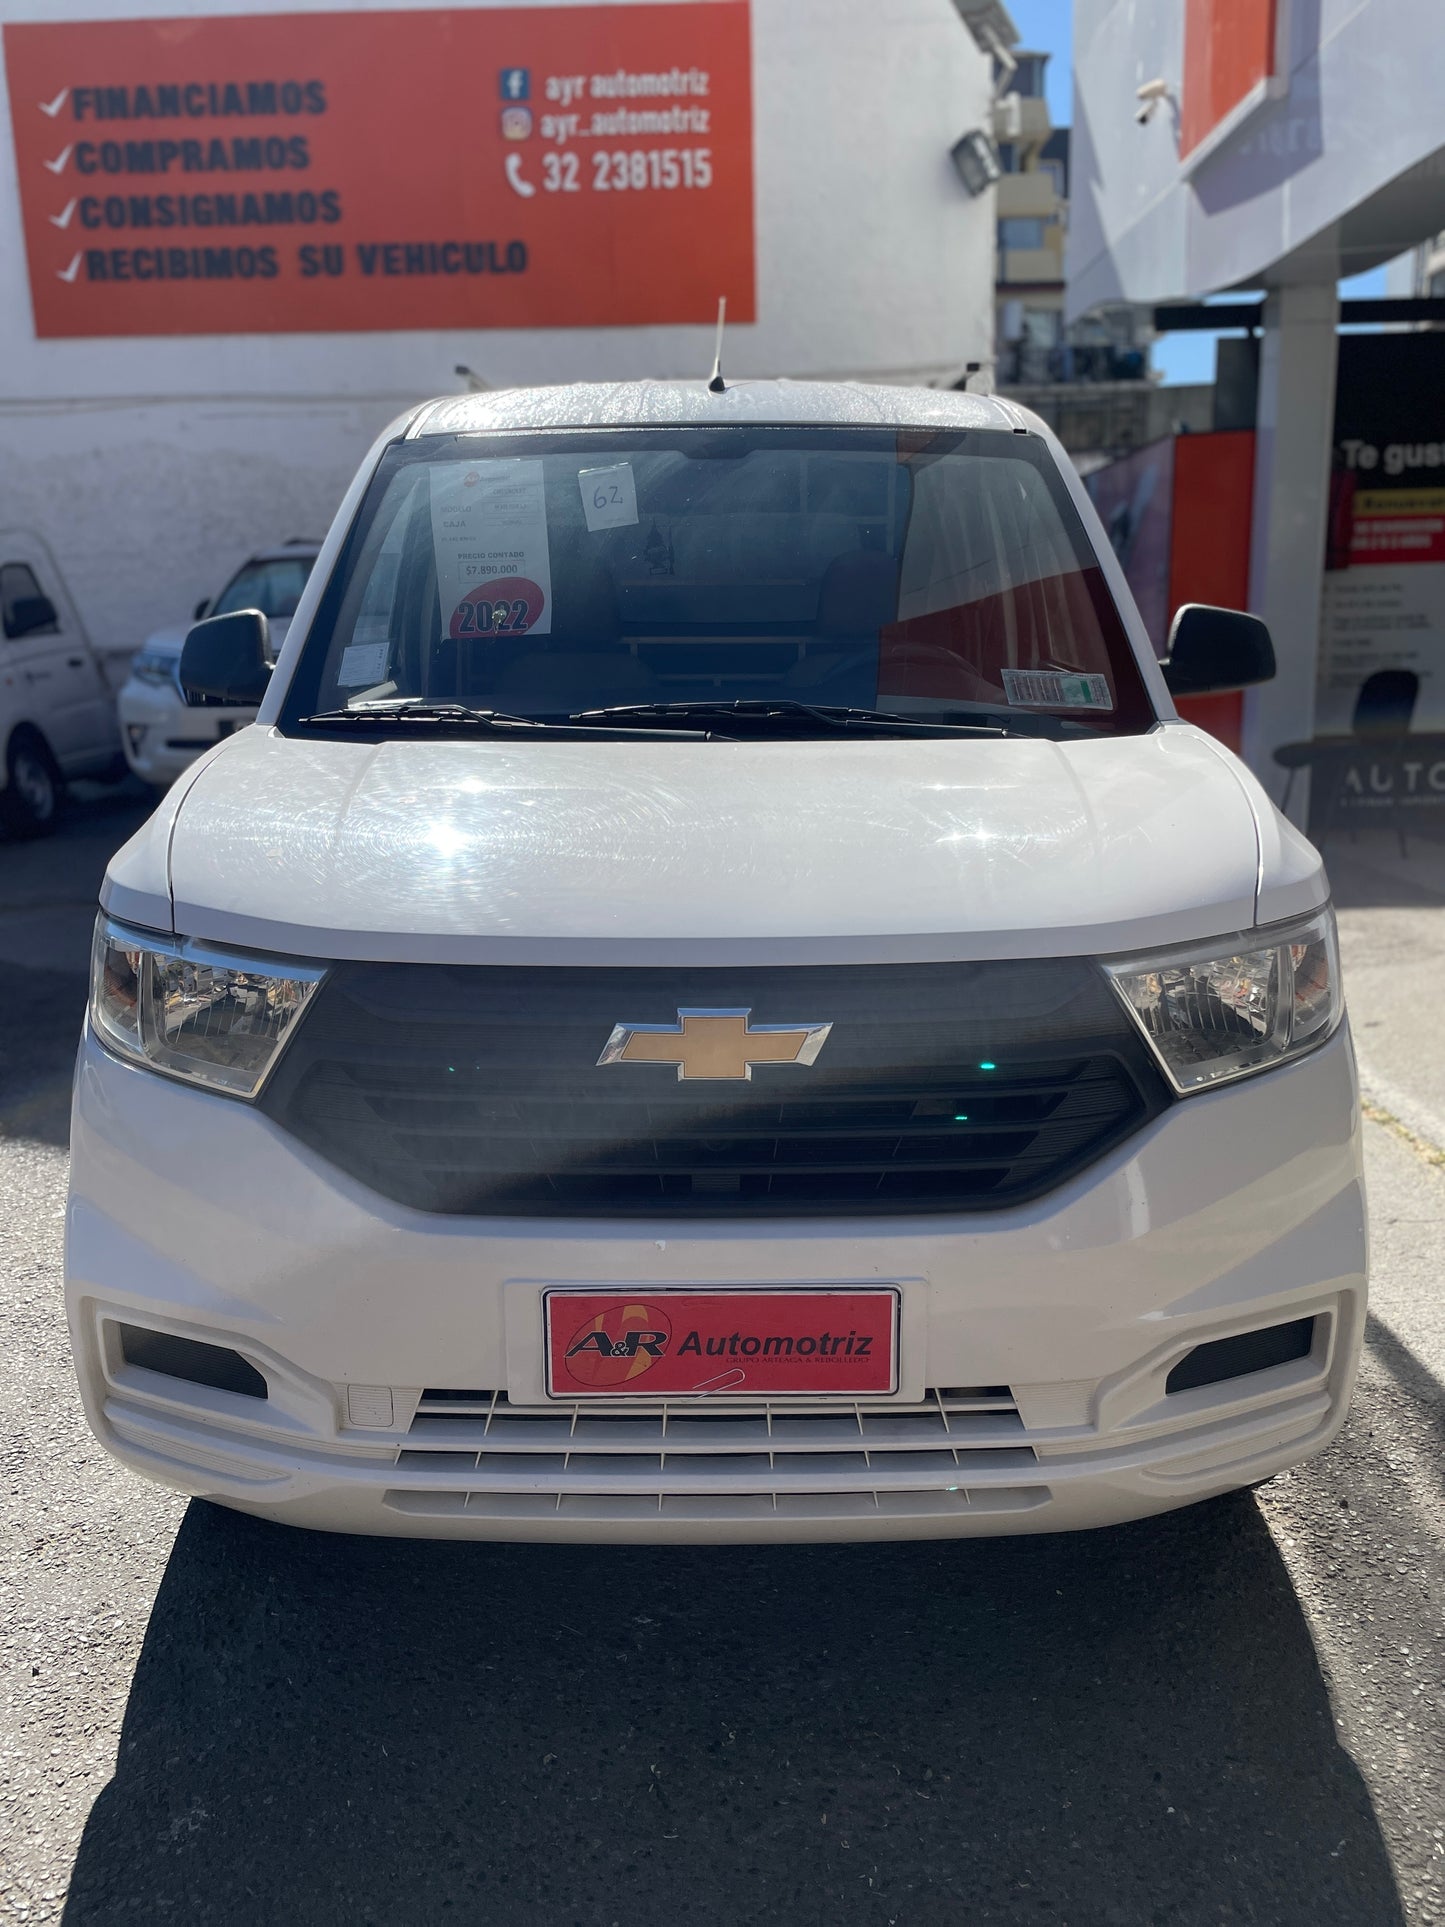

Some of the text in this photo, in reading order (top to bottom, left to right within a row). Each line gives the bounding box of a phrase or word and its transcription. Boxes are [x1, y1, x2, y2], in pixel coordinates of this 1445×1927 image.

[72, 81, 327, 121] FINANCIAMOS
[545, 67, 709, 107] ayr automotriz
[75, 136, 310, 174] COMPRAMOS
[542, 148, 712, 192] 32 2381515
[79, 190, 342, 229] CONSIGNAMOS
[86, 240, 527, 282] RECIBIMOS SU VEHICULO
[1340, 439, 1445, 475] Te gus
[457, 551, 525, 560] PRECIO CONTADO
[458, 599, 529, 634] 2022
[563, 1330, 872, 1358] A&R Automotriz
